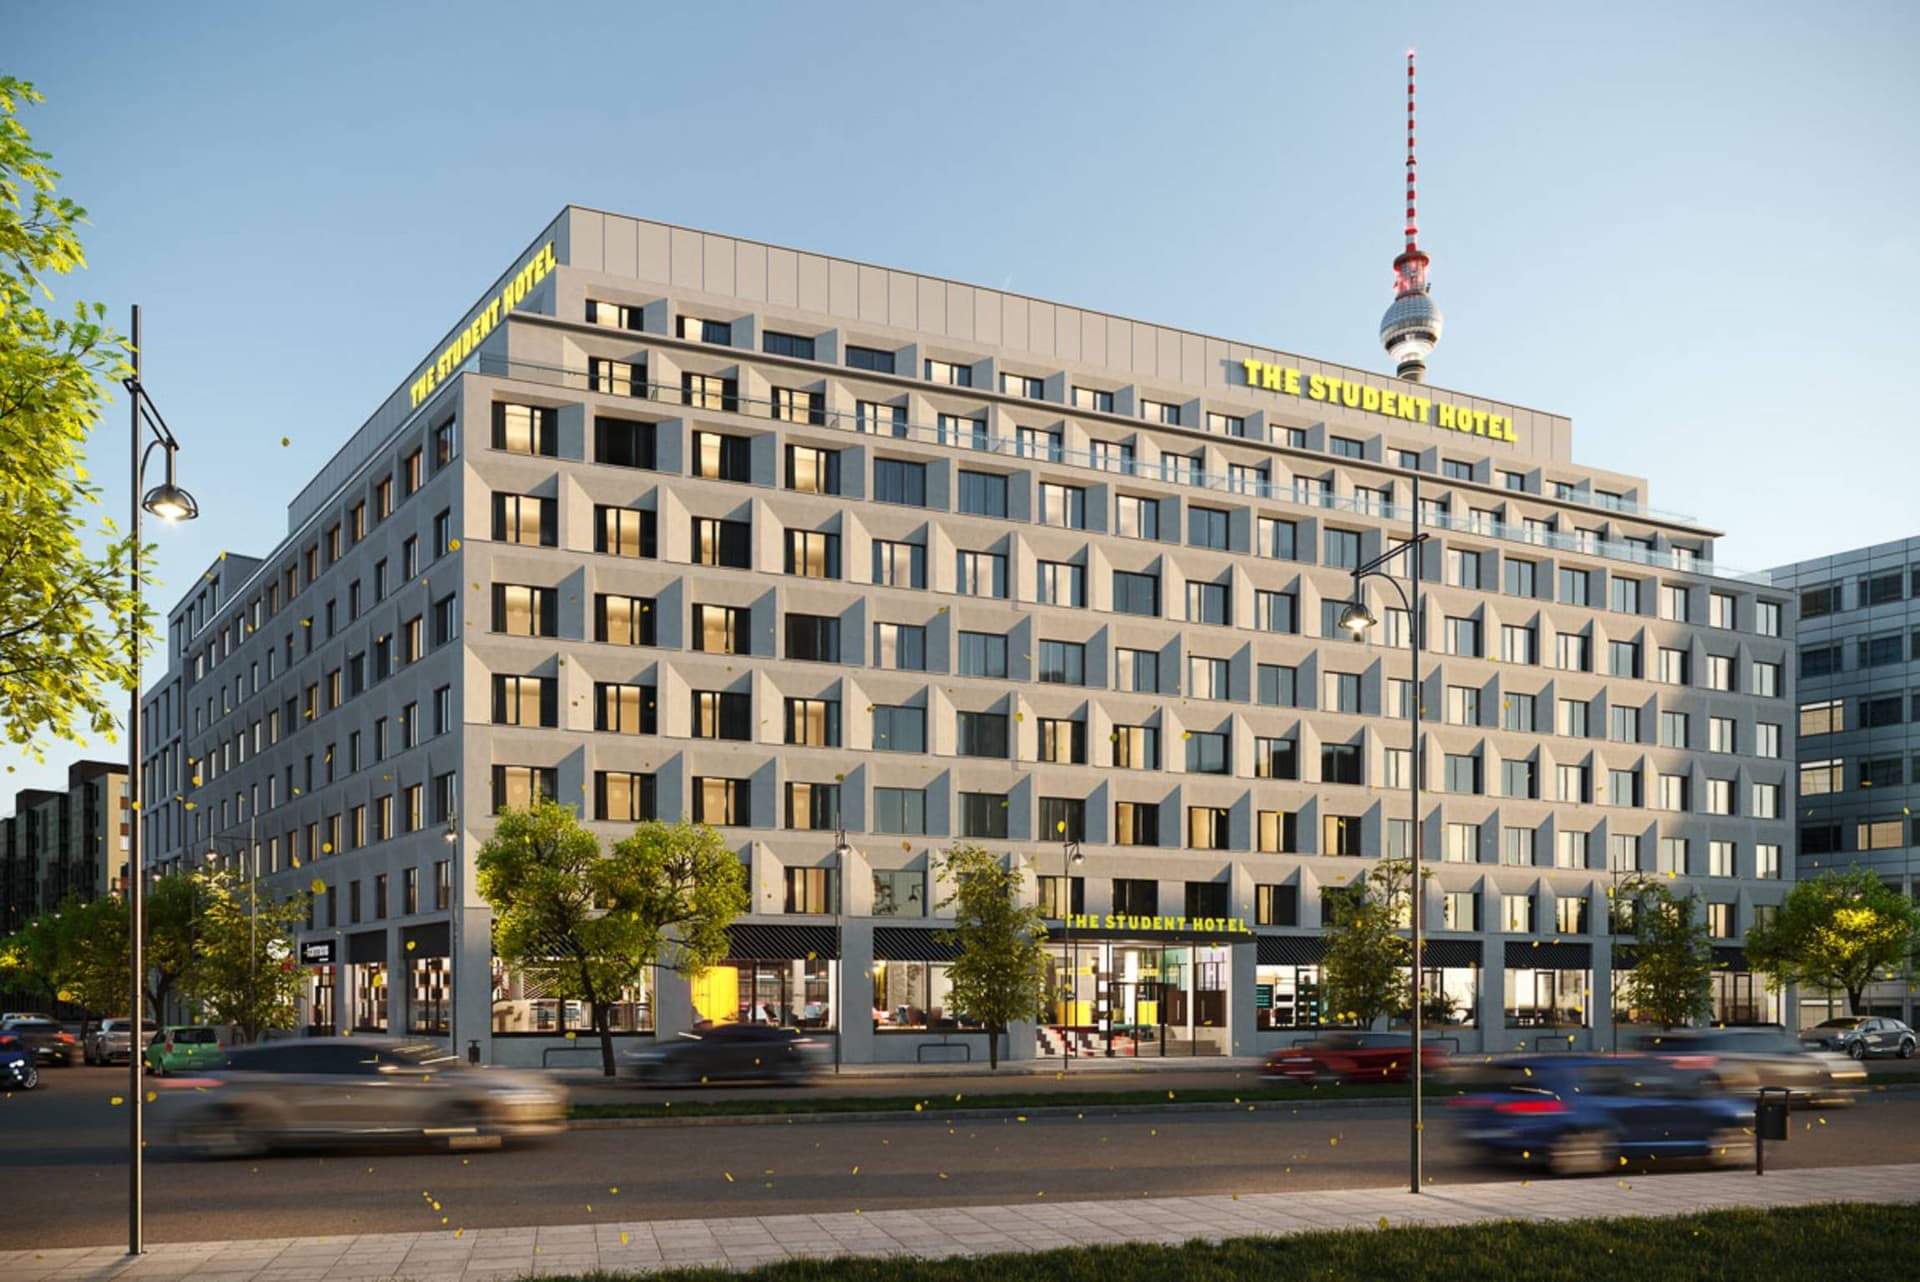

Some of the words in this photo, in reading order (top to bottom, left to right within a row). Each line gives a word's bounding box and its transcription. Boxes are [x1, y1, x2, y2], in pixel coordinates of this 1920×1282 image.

[411, 366, 437, 408] THE
[437, 297, 501, 382] STUDENT
[504, 240, 557, 315] HOTEL
[1243, 358, 1301, 395] THE
[1308, 374, 1432, 423] STUDENT
[1438, 401, 1518, 442] HOTEL
[1065, 914, 1099, 929] THE
[1105, 914, 1186, 931] STUDENT
[1192, 917, 1248, 932] HOTEL
